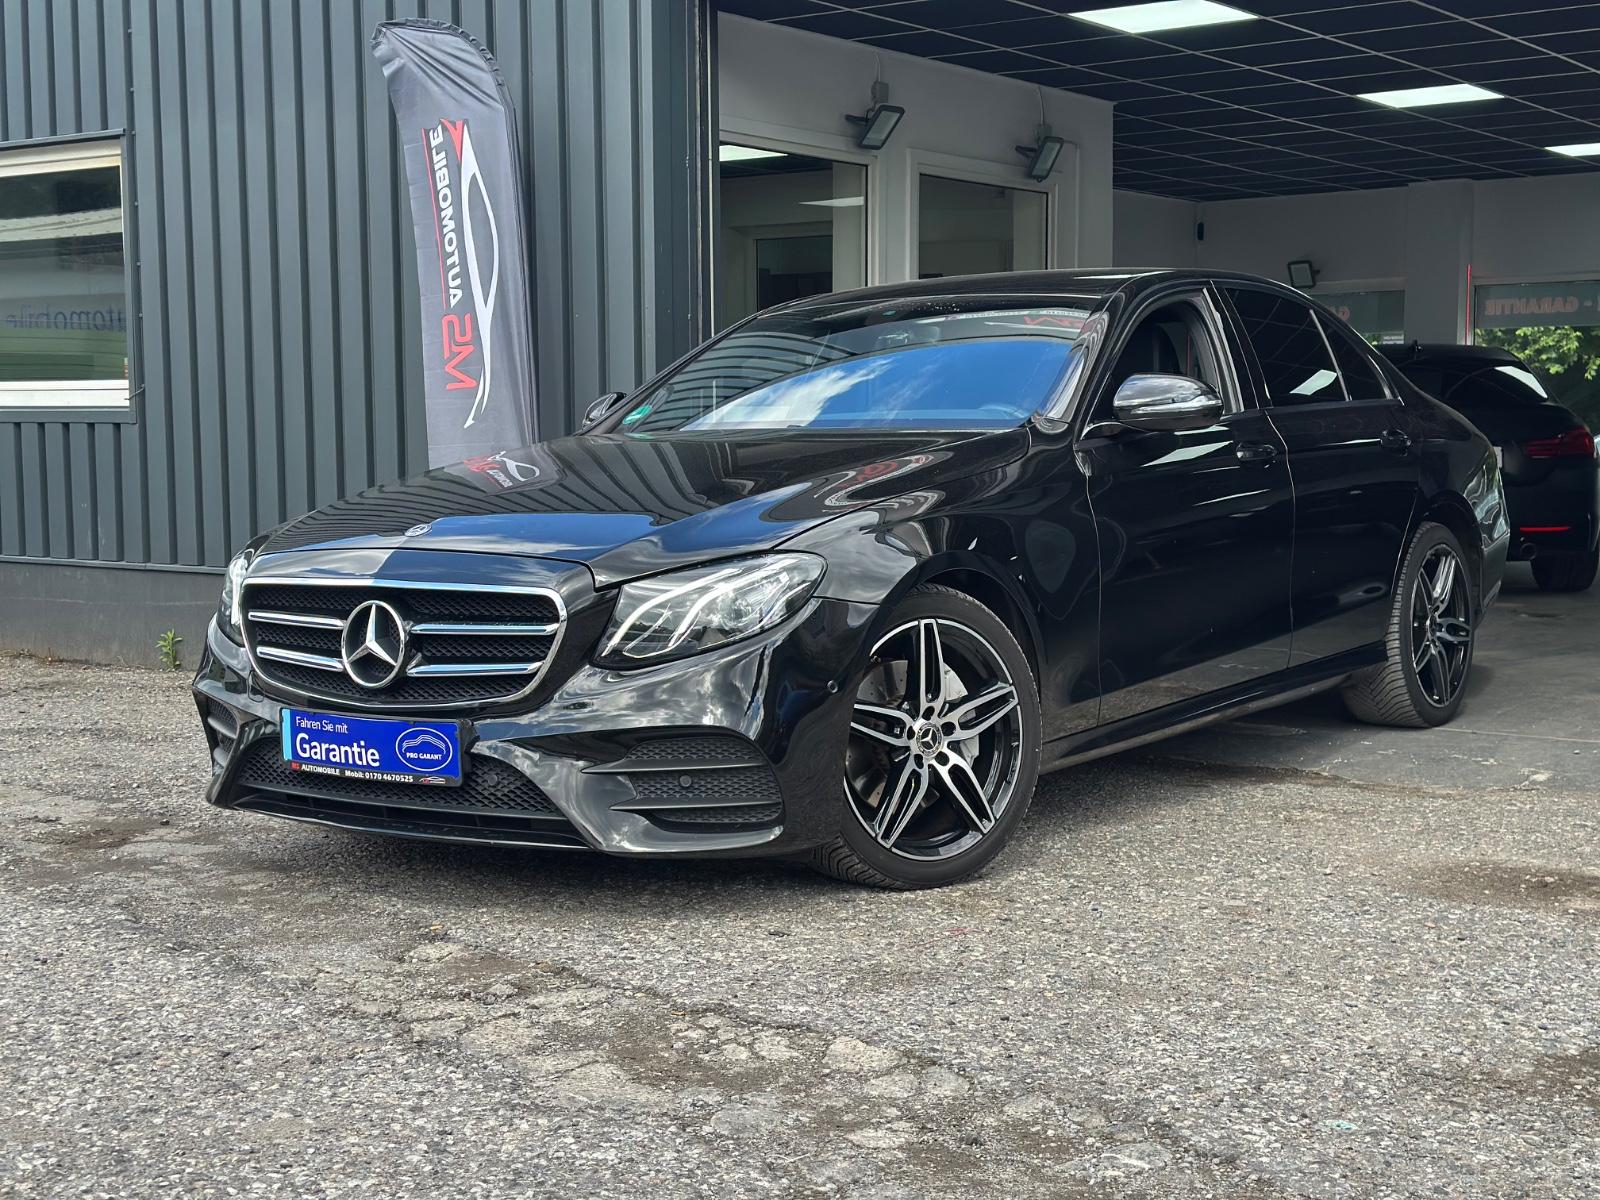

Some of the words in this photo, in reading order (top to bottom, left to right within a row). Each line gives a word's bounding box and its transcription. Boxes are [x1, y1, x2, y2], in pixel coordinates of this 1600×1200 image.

[295, 716, 321, 730] Fahren
[322, 720, 334, 732] Sie
[335, 723, 348, 734] mit
[295, 732, 380, 767] Garantie
[301, 763, 340, 776] AUTOMOBILE
[365, 772, 382, 780] 0170
[383, 773, 414, 783] 4670525
